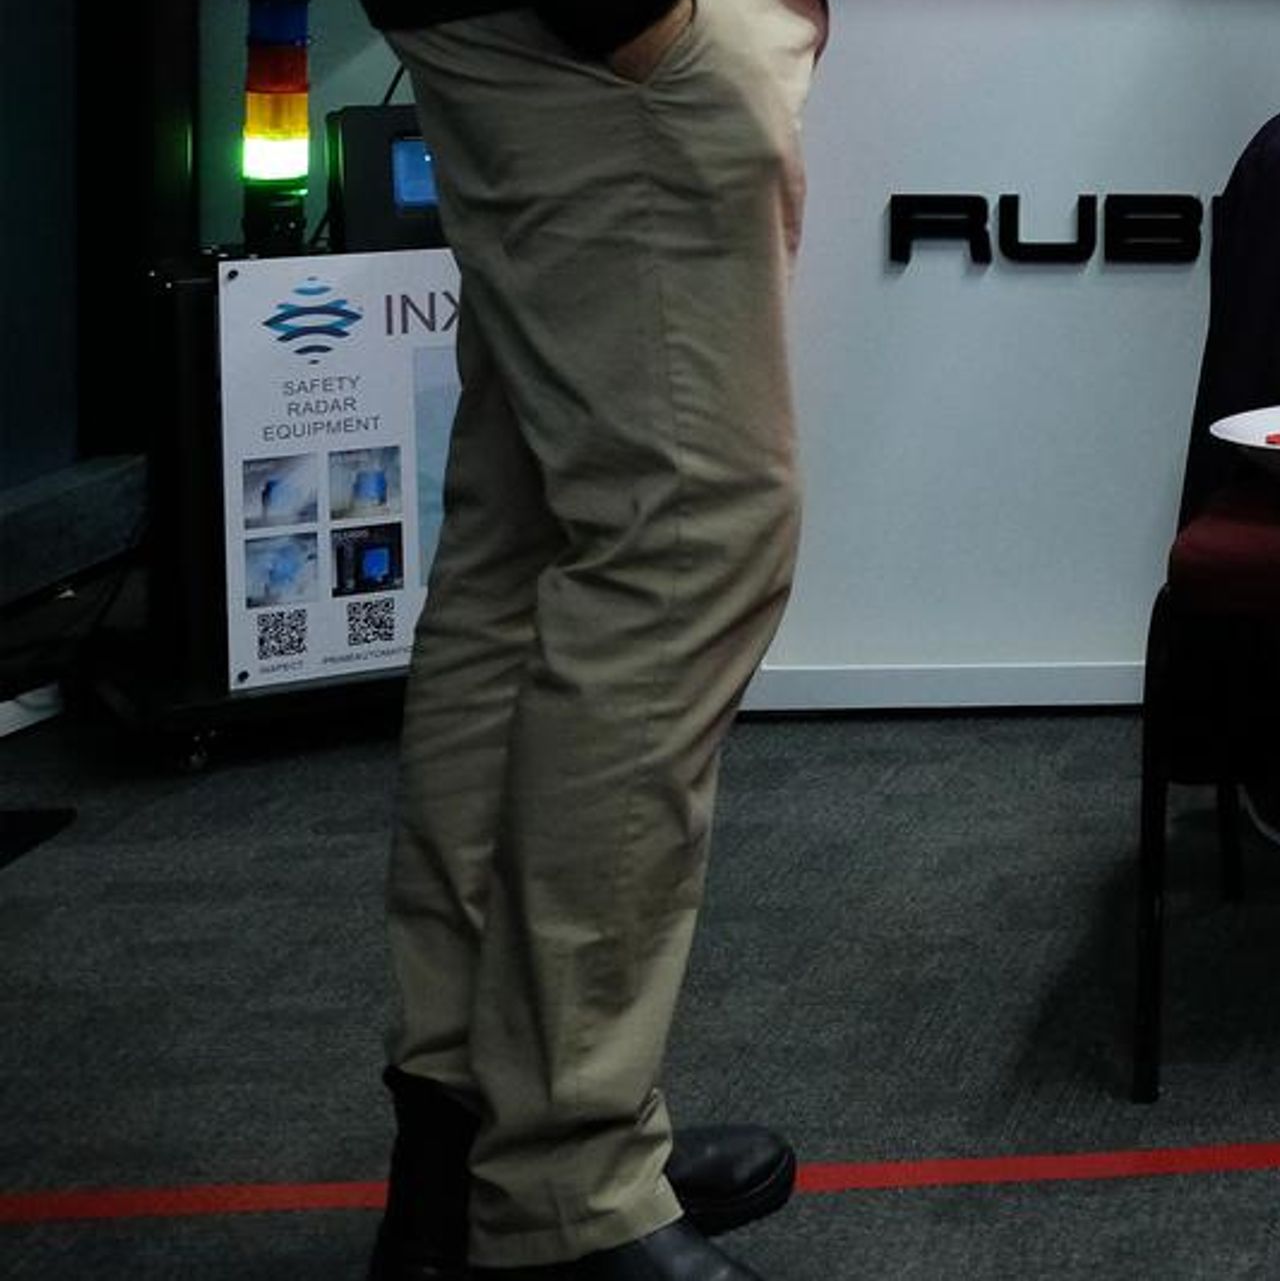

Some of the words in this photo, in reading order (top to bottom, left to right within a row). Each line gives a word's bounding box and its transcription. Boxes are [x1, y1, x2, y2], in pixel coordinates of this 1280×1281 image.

[282, 375, 361, 397] SAFETY
[287, 396, 357, 417] RADAR
[262, 416, 381, 442] EQUIPMENT
